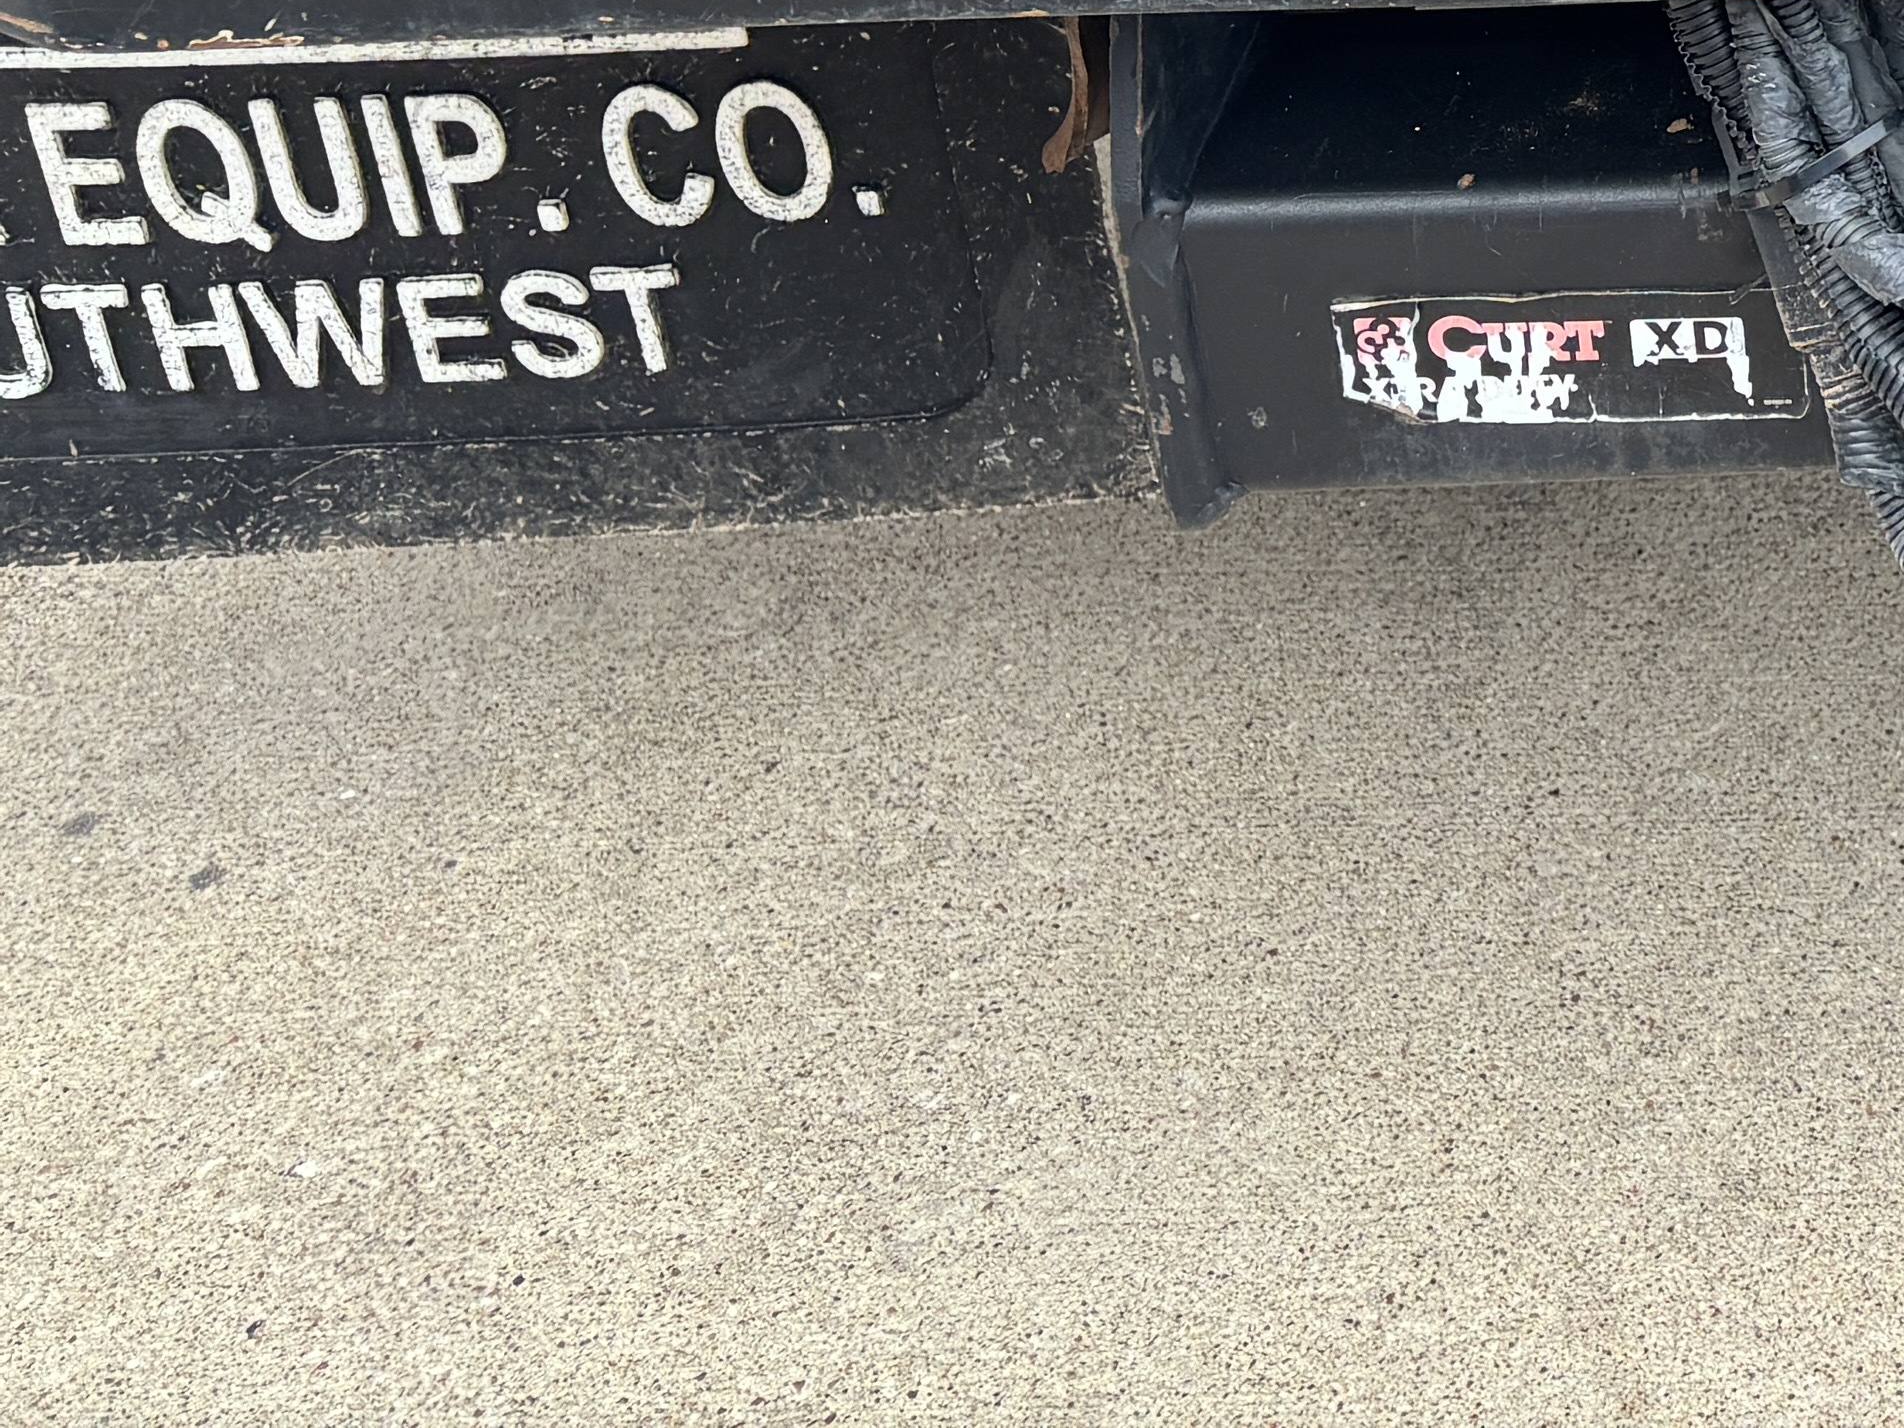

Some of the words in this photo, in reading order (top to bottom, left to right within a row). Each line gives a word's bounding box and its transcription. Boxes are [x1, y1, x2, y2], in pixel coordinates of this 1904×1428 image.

[26, 93, 569, 253] EQUIP.
[601, 80, 885, 227] CO.
[1644, 320, 1729, 356] XD
